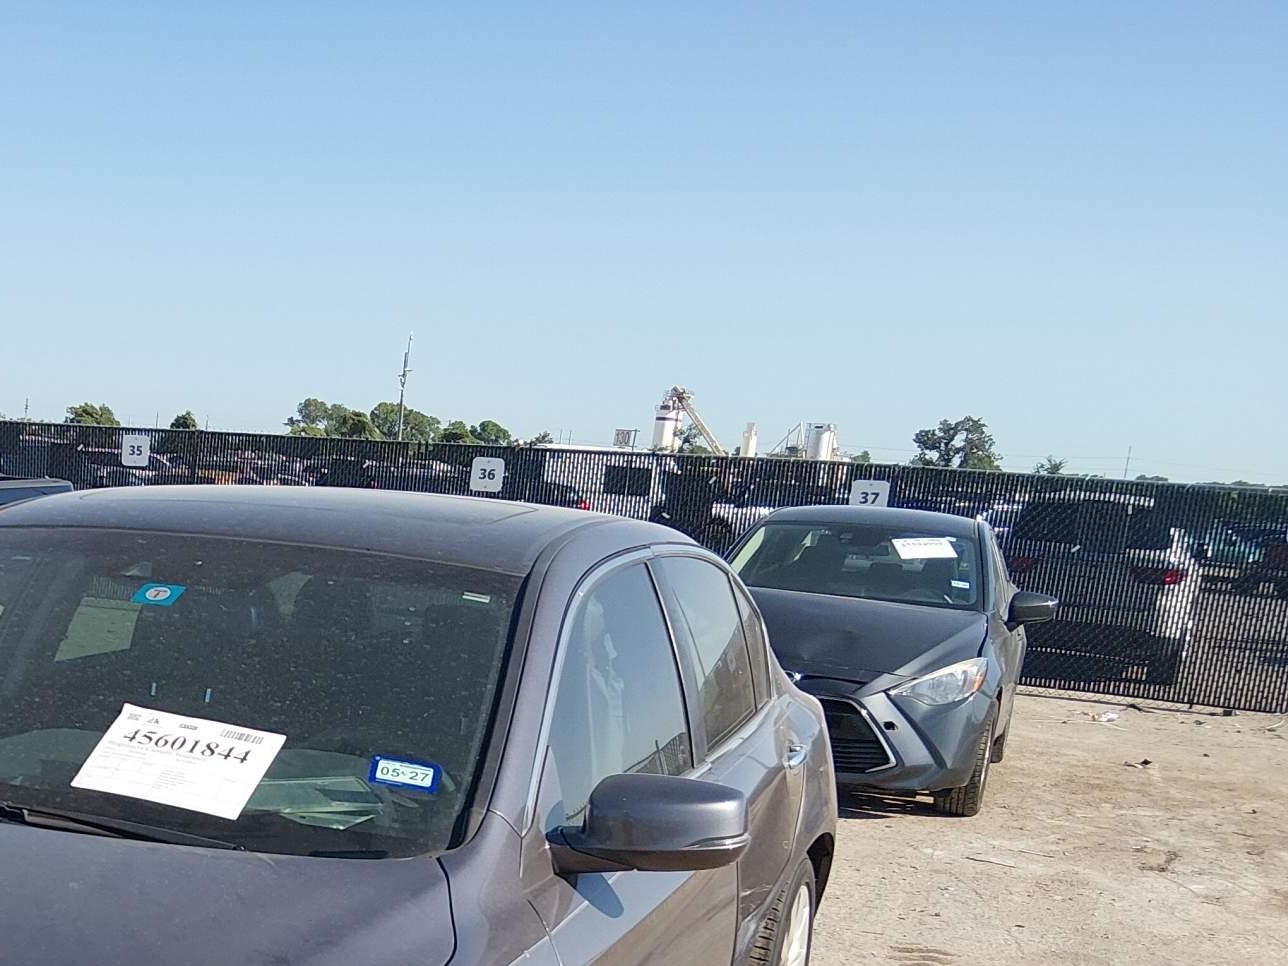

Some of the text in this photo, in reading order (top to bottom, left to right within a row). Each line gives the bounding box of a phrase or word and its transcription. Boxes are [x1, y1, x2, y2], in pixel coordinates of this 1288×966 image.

[128, 444, 143, 457] 35
[478, 468, 496, 481] 36
[859, 492, 880, 504] 37
[123, 728, 251, 764] 45601844
[380, 766, 430, 782] 05 27
